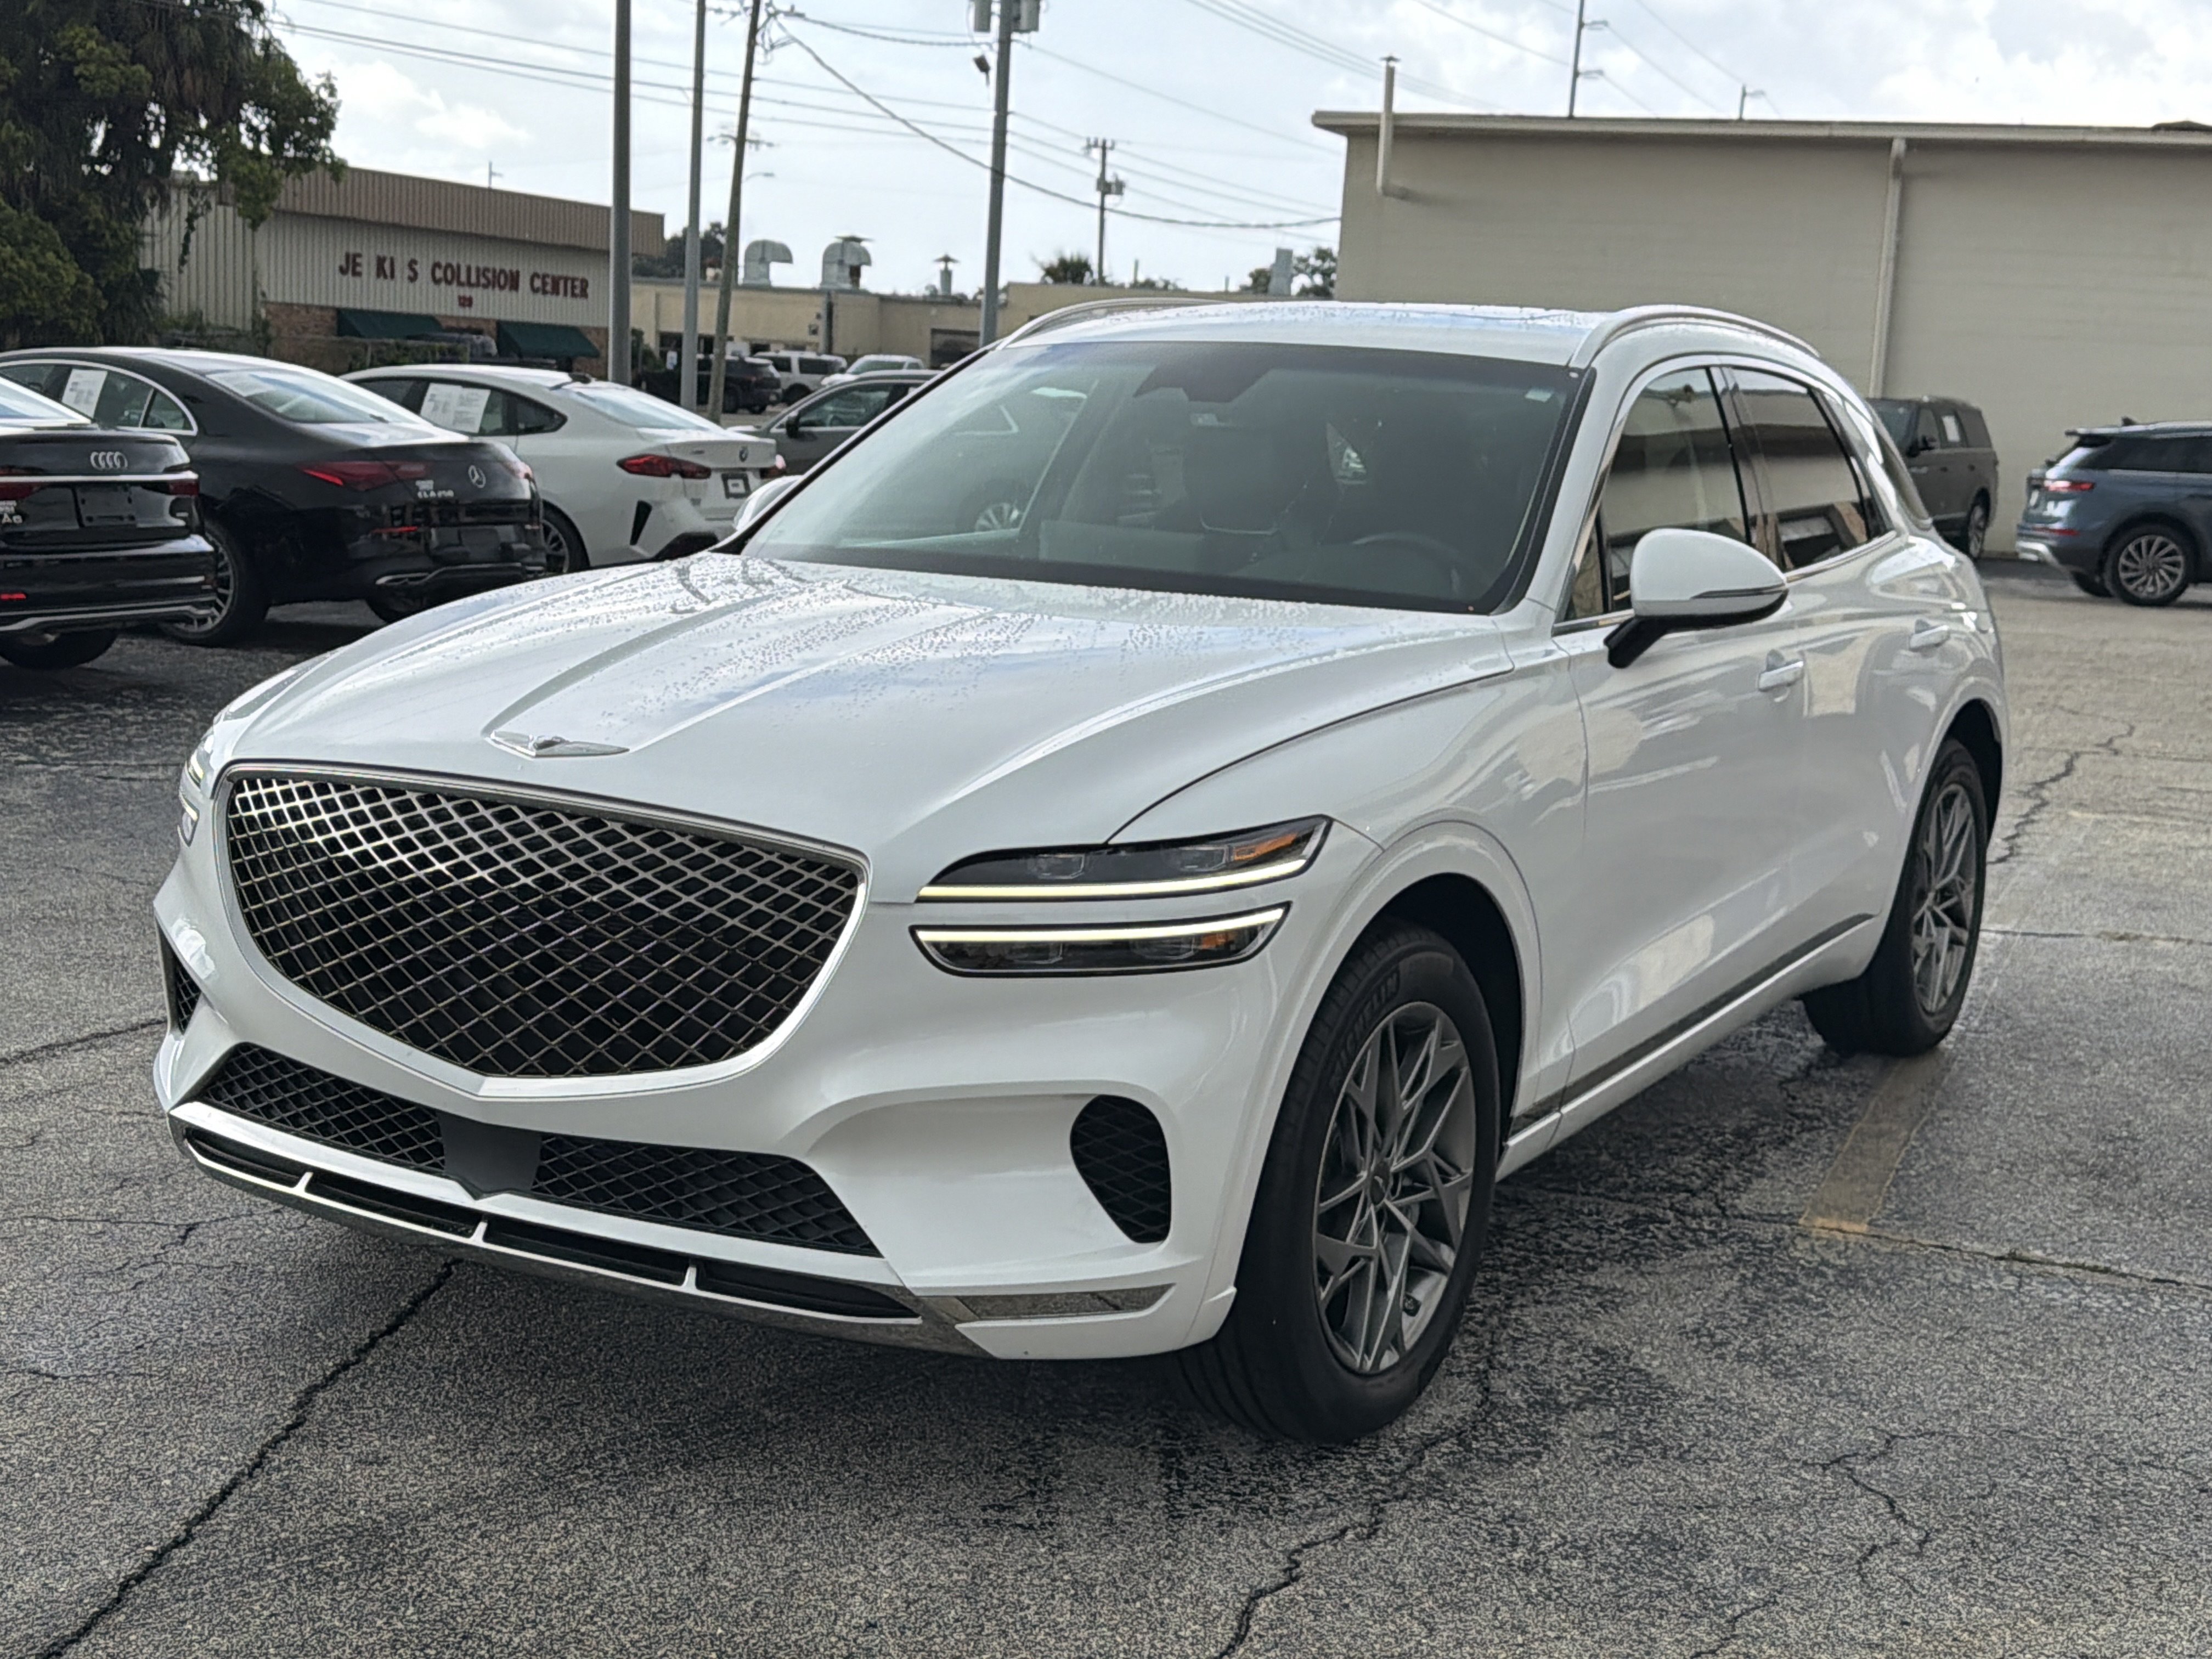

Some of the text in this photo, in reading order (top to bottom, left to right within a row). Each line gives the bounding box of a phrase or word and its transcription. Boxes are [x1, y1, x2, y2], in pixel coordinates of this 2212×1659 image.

[338, 252, 589, 300] JE KI S COLLISION CENTER
[1329, 972, 1397, 1091] MICHELIN
